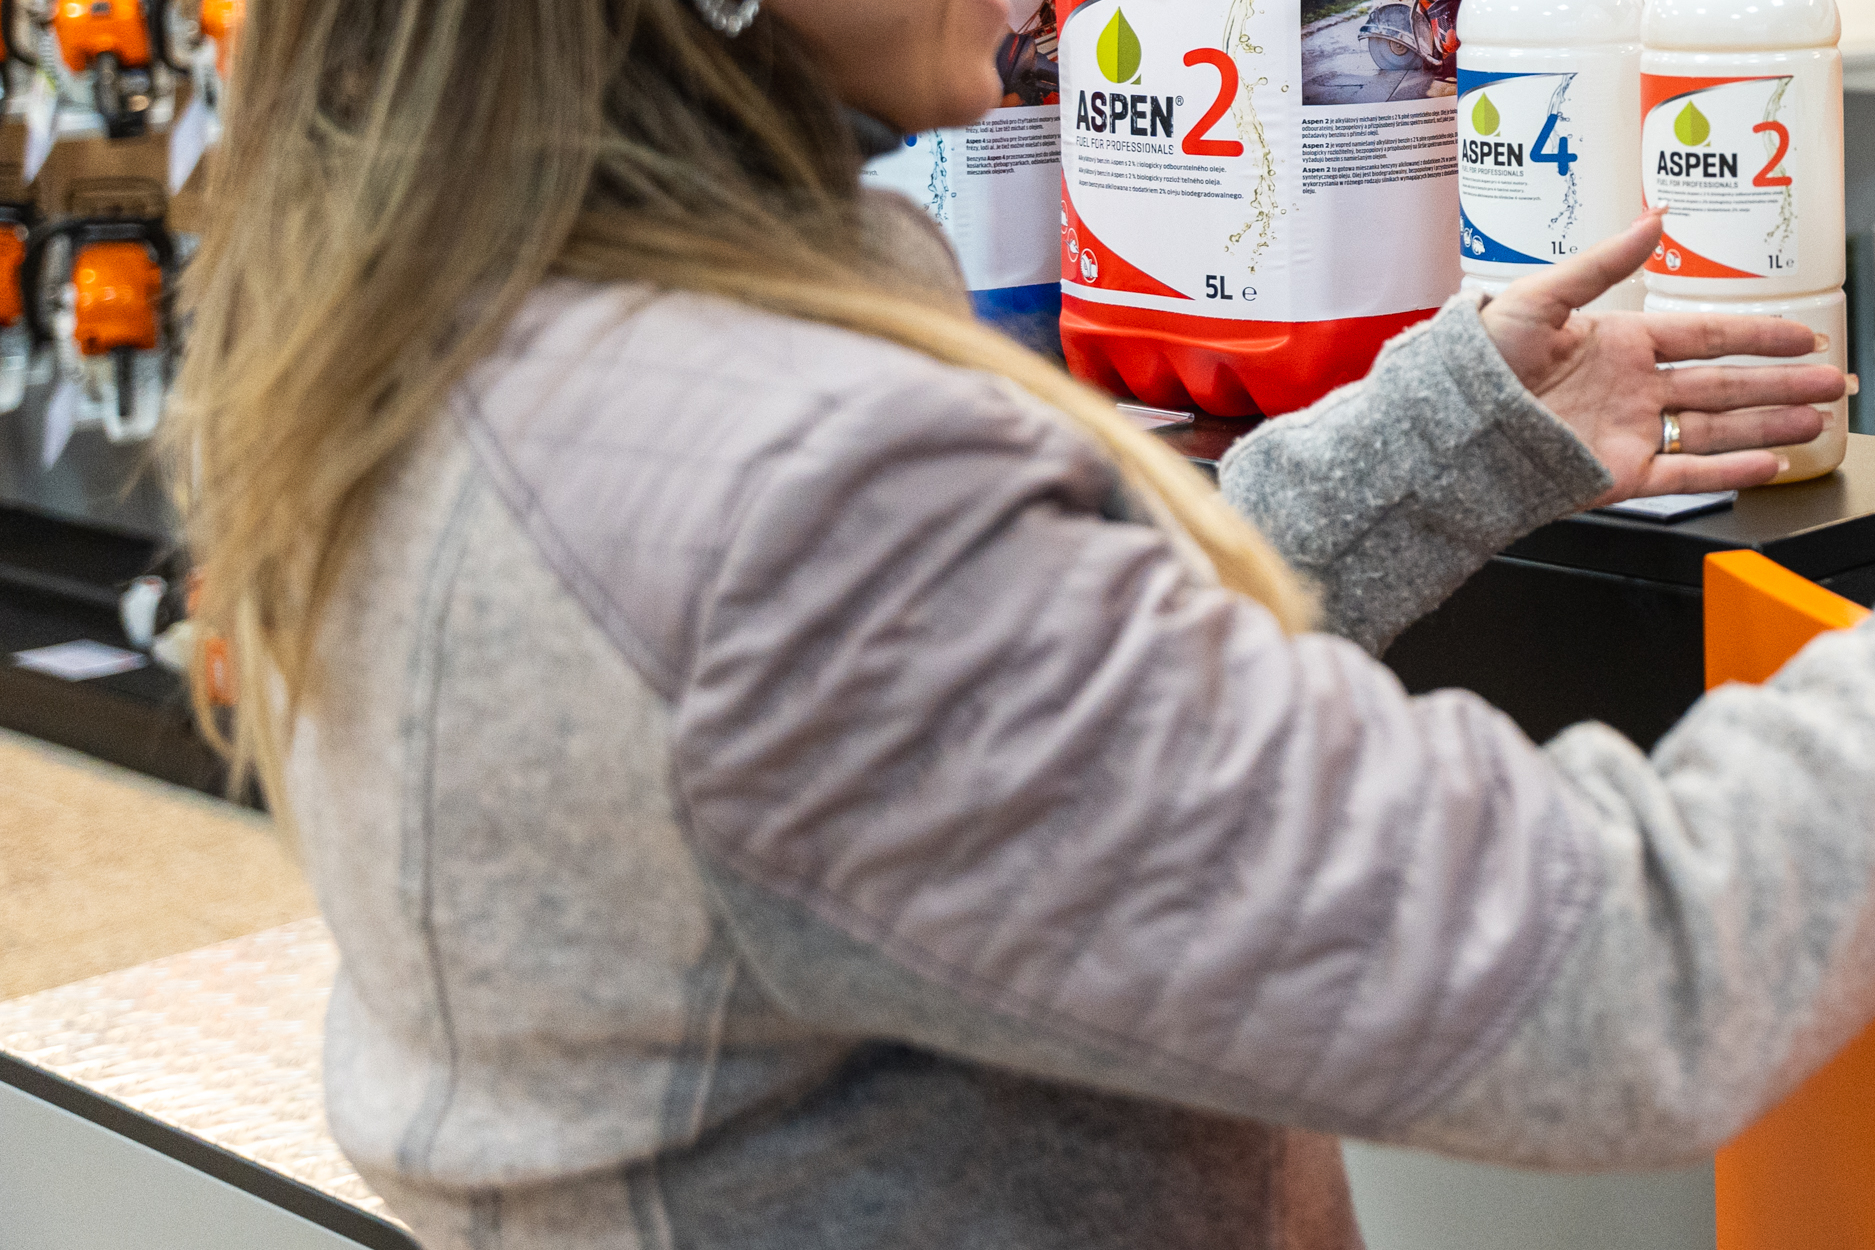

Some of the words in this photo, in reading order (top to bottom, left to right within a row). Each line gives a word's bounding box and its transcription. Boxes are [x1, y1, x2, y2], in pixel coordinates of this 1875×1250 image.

[1181, 47, 1244, 157] 2
[1076, 135, 1090, 148] FUEL
[1091, 137, 1104, 150] FOR
[1105, 138, 1175, 155] PROFESSIONALS
[1462, 138, 1524, 167] ASPEN
[1529, 113, 1578, 177] 4
[1657, 150, 1739, 179] ASPEN
[1751, 121, 1793, 188] 2
[1477, 168, 1525, 178] PROFESSIONALS
[1551, 240, 1567, 255] 1L
[1768, 254, 1784, 270] 1L
[1205, 273, 1233, 300] 5L
